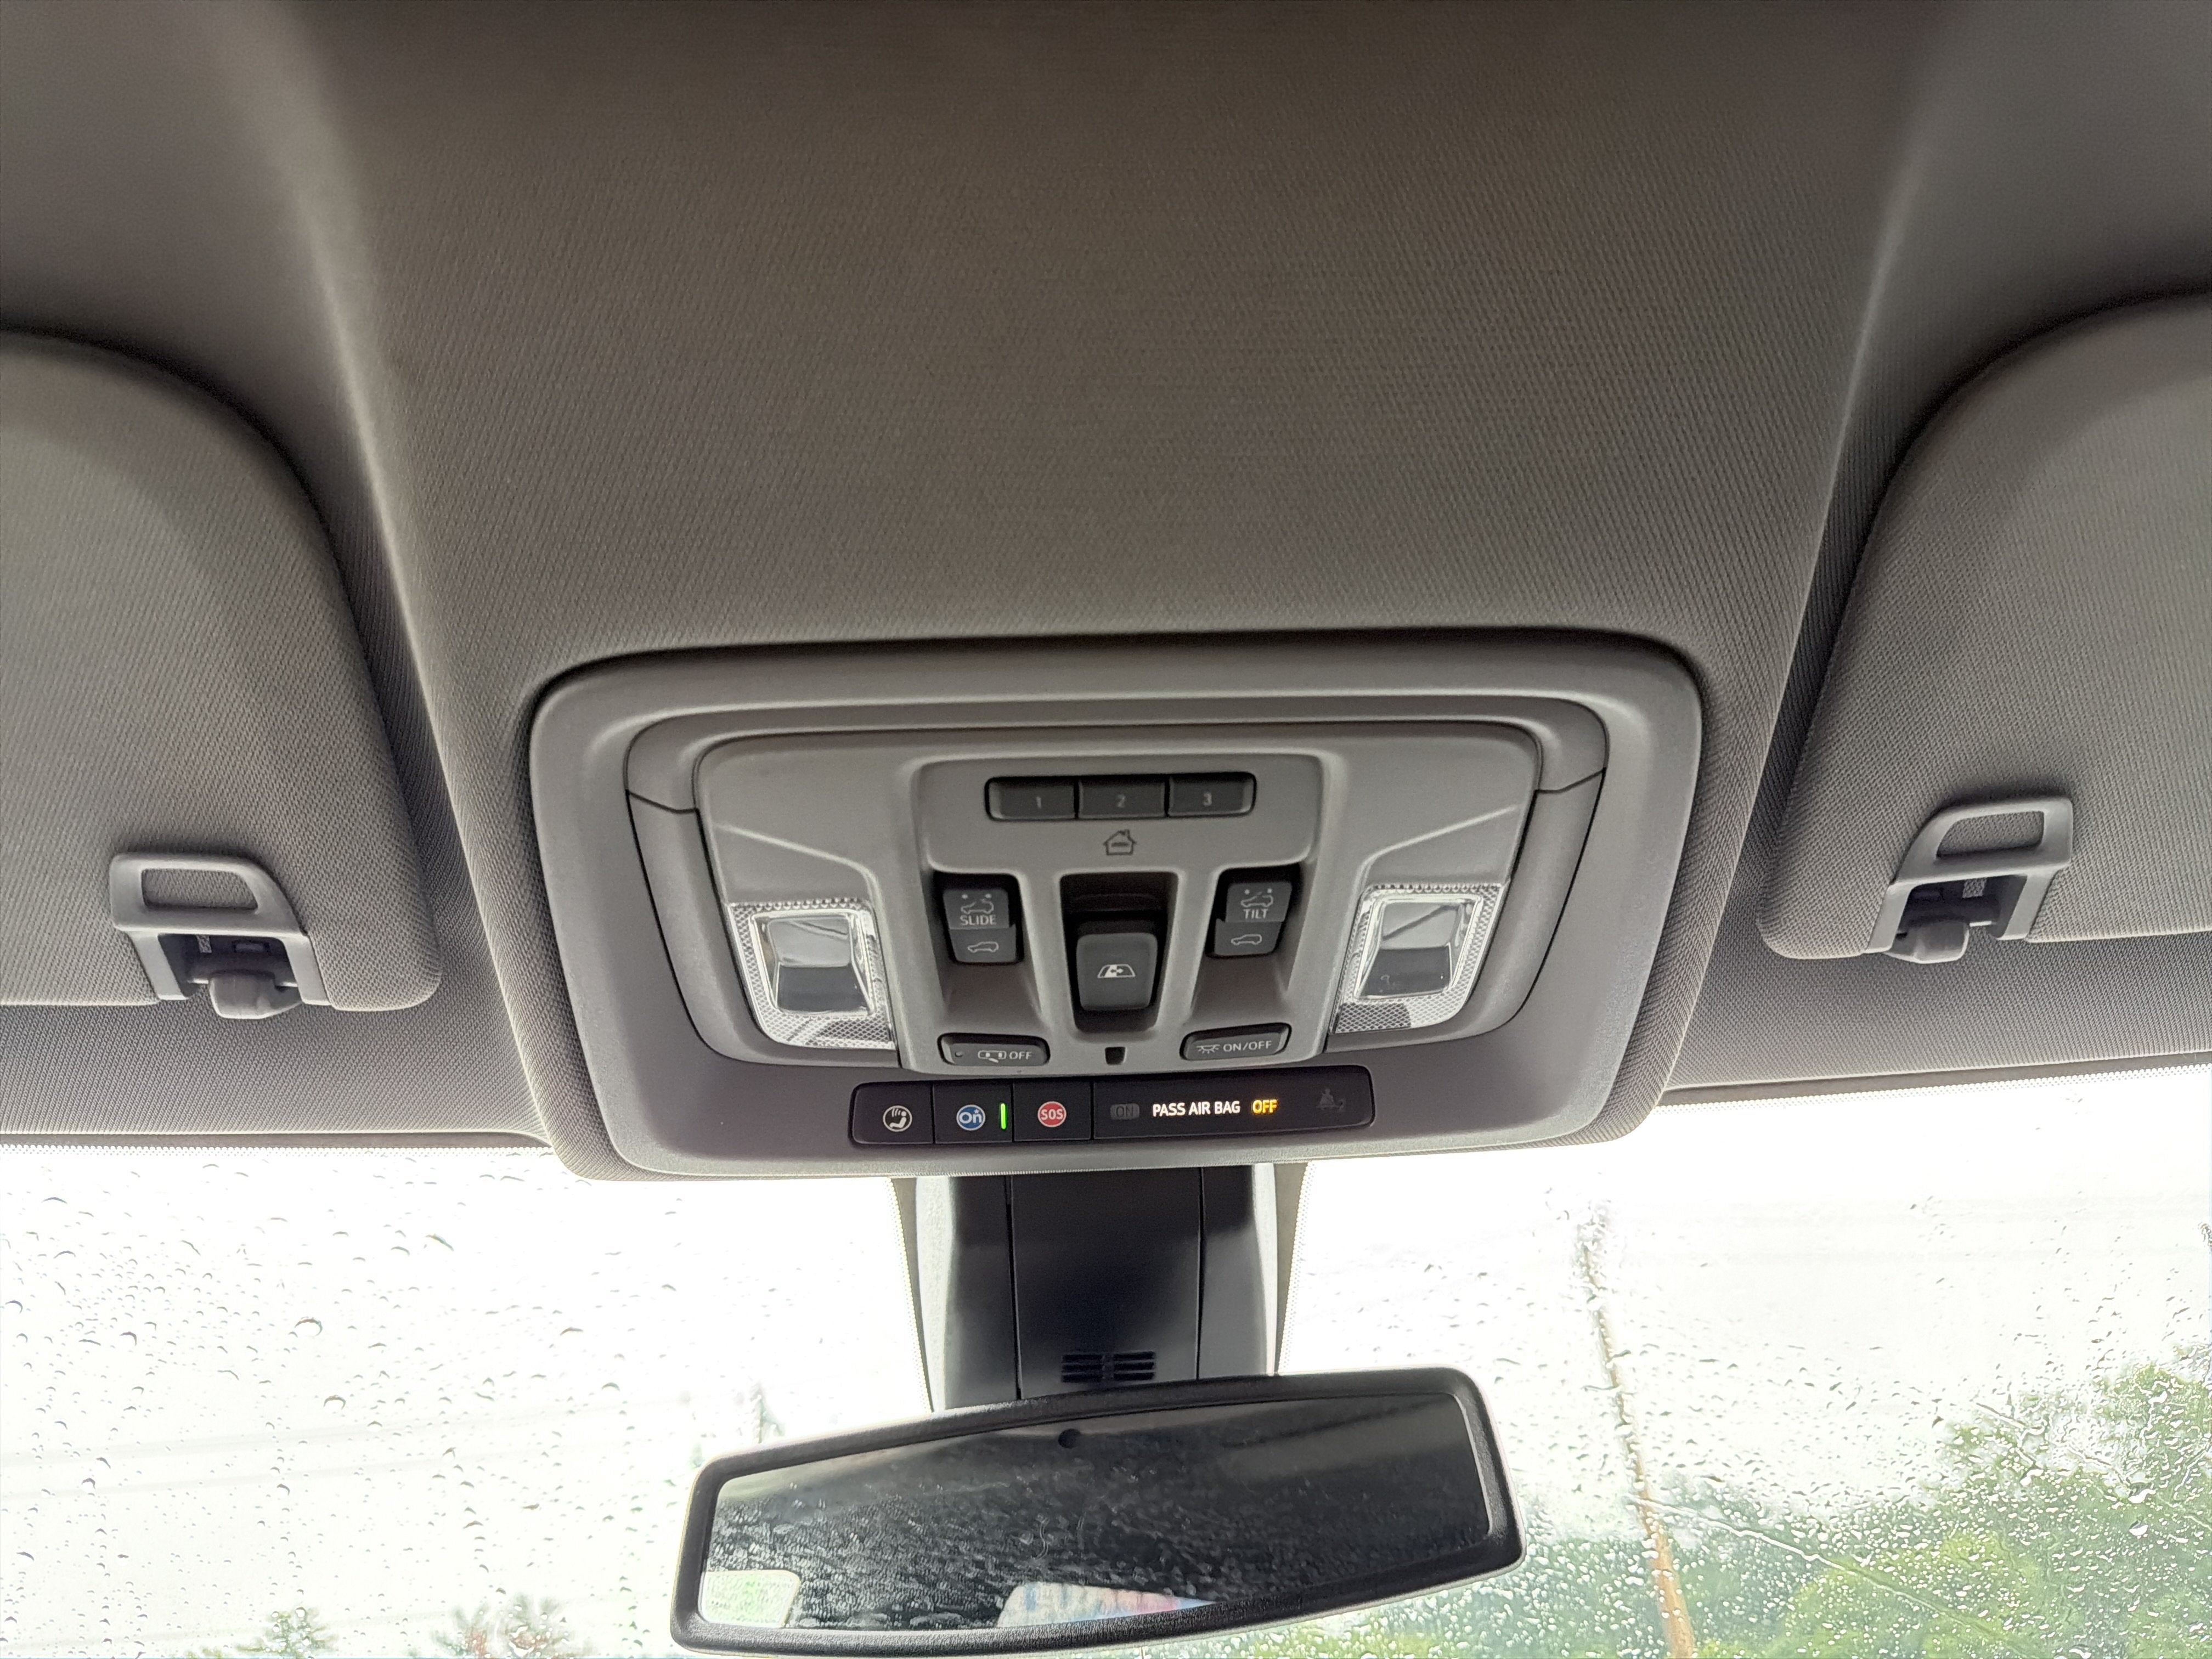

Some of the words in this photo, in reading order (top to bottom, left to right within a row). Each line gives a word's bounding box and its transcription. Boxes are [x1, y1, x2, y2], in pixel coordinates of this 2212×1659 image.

[1036, 796, 1042, 808] 1
[1117, 794, 1126, 808] 2
[1203, 792, 1212, 806] 3
[1243, 909, 1269, 919] TILT
[960, 915, 997, 926] SLIDE
[1222, 1040, 1273, 1053] ON/OFF
[1009, 1051, 1032, 1060] OFF
[1116, 1105, 1134, 1117] ON
[1153, 1103, 1186, 1117] PASS
[1188, 1102, 1210, 1115] AIR
[1214, 1101, 1240, 1114] BAG
[1252, 1099, 1277, 1114] OFF
[1041, 1109, 1063, 1120] SOS
